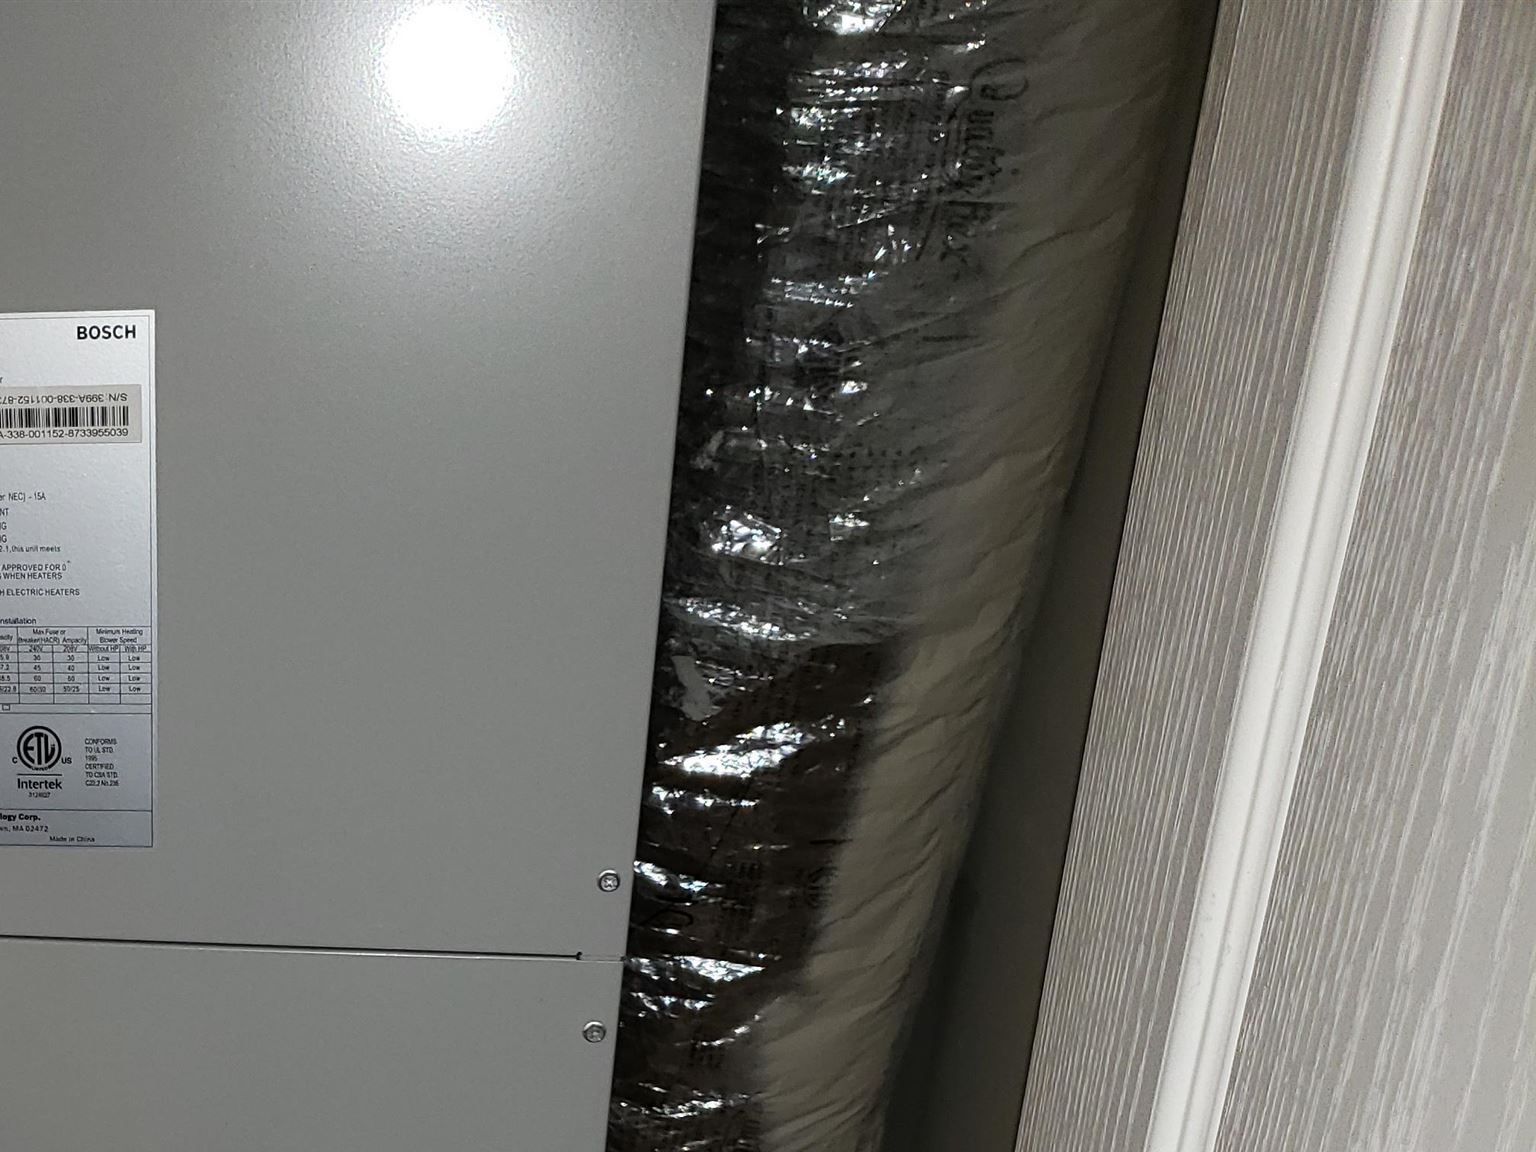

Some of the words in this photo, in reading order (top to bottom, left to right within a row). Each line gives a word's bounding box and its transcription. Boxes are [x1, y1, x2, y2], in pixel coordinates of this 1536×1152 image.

[76, 325, 137, 340] BOSCH
[34, 491, 46, 500] 15A
[4, 572, 26, 580] WHEN
[27, 572, 63, 580] HEATERS
[84, 738, 117, 746] CONFORMS
[61, 757, 72, 765] US
[17, 778, 63, 790] Intertek
[18, 813, 41, 822] Corp.
